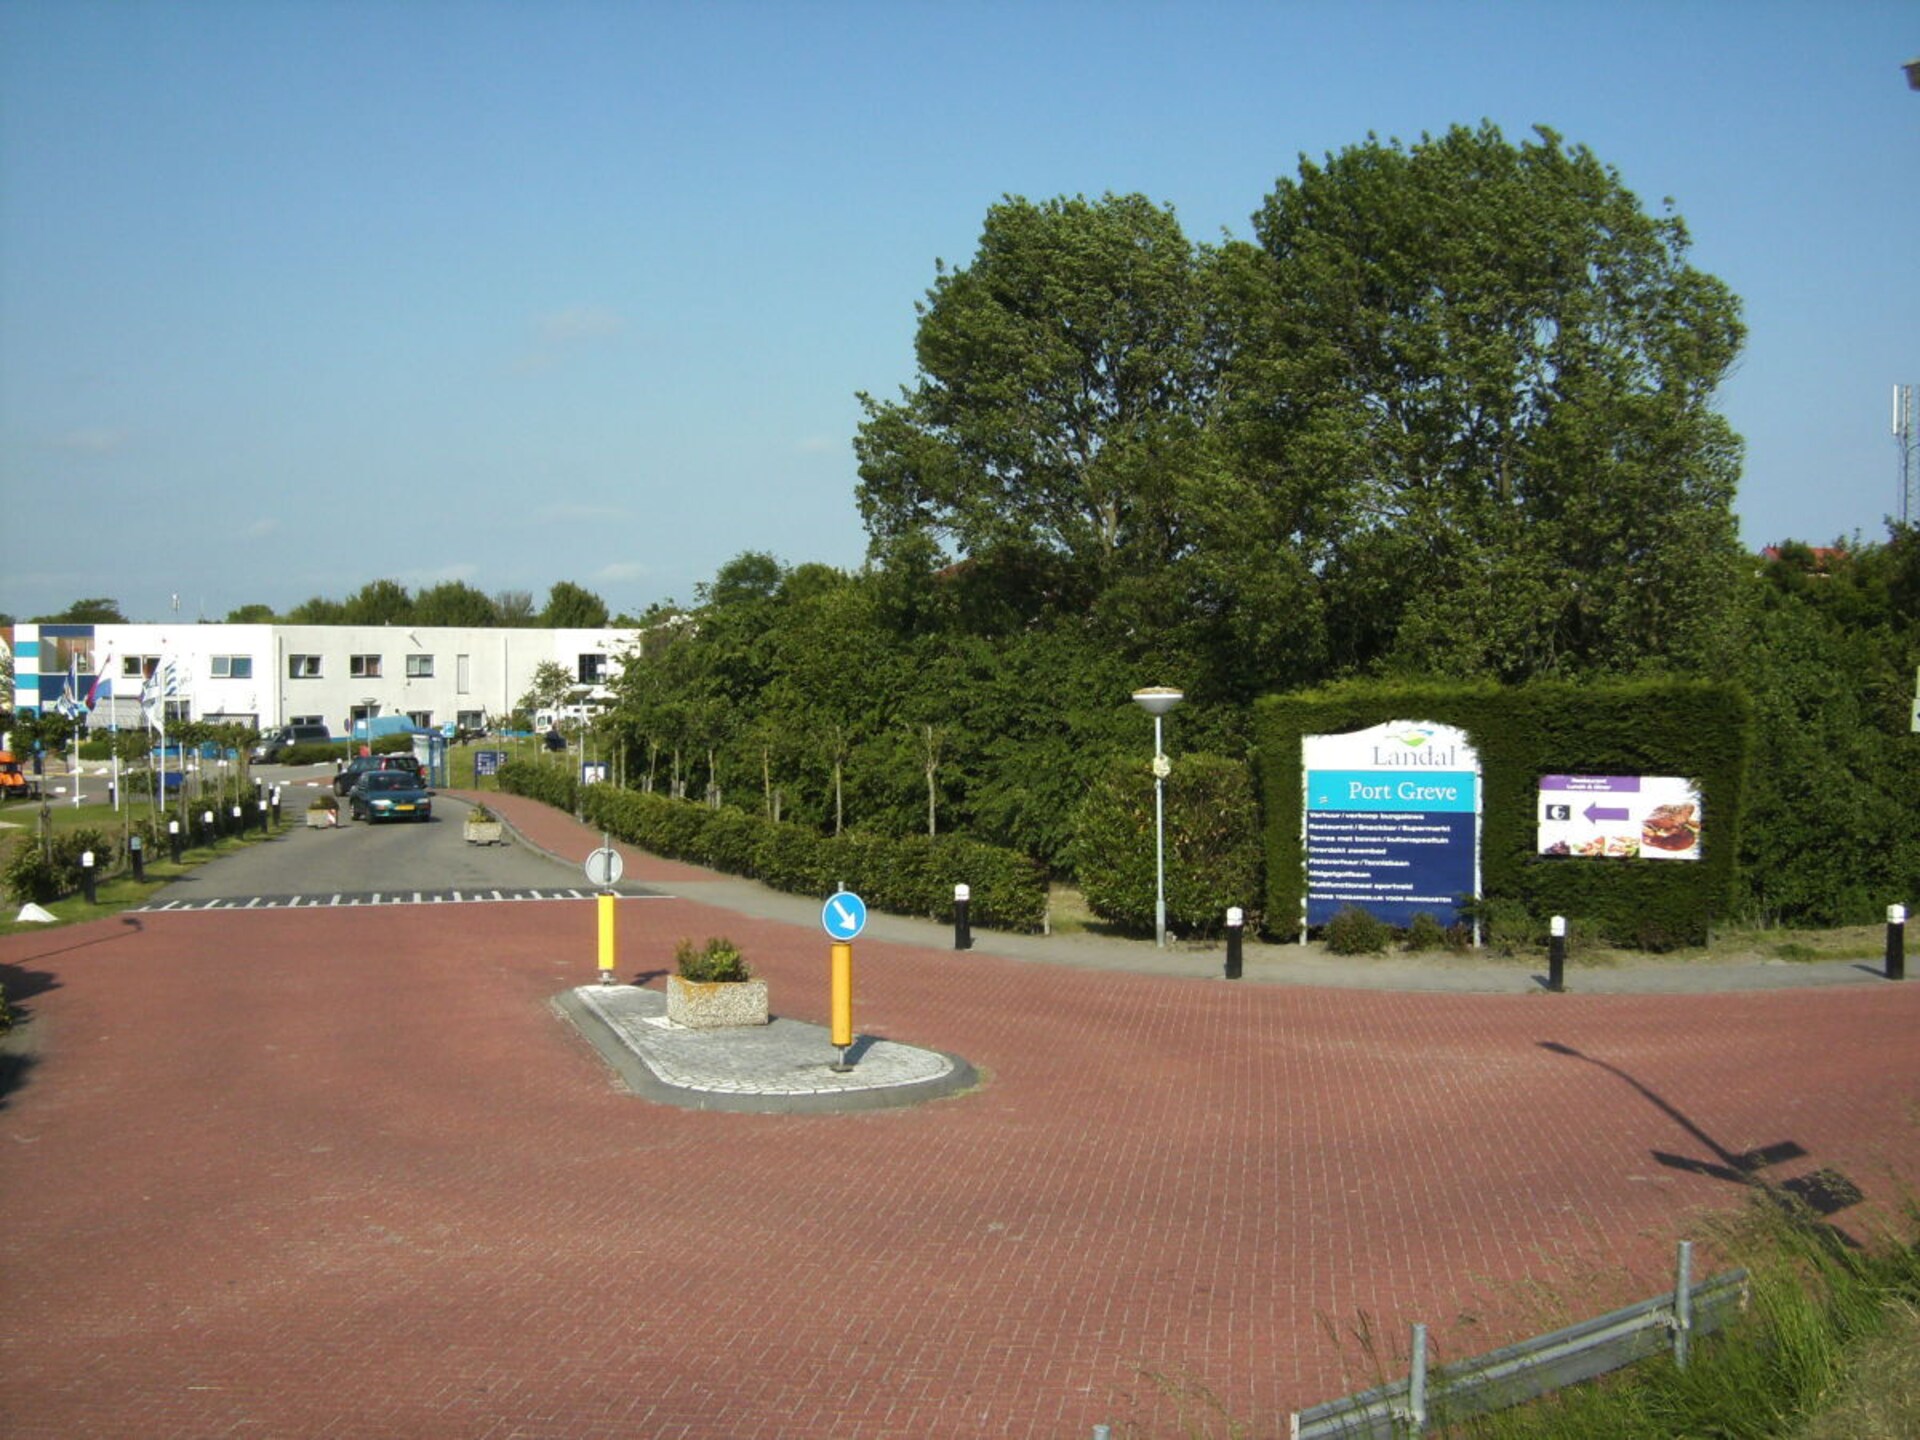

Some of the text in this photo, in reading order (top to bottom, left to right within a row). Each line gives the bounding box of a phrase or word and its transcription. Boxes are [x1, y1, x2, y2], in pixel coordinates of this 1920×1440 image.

[1373, 745, 1456, 767] Landal
[1348, 781, 1457, 801] Port Greve
